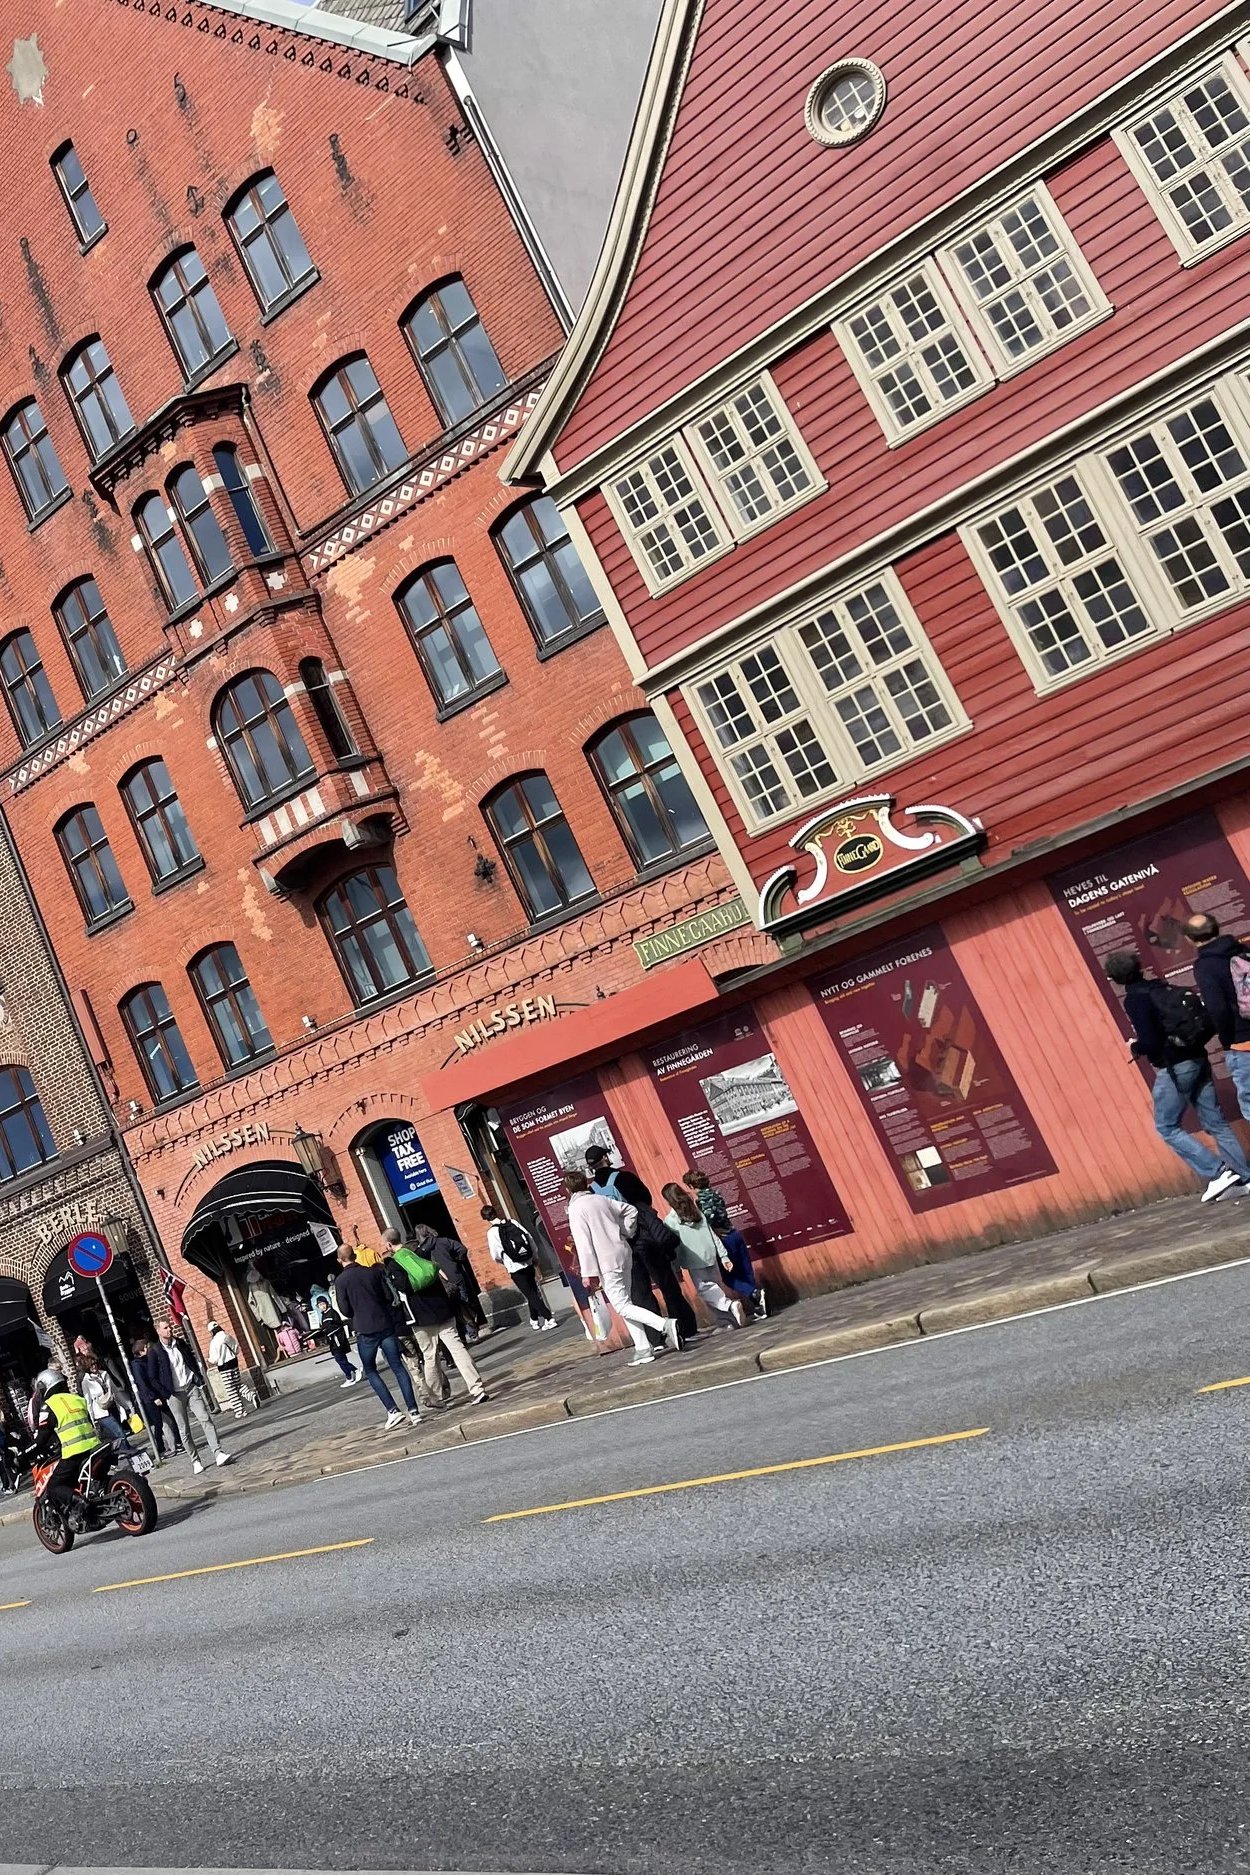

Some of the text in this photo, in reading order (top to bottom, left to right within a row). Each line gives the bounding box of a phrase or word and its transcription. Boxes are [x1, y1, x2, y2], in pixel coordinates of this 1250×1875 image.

[1063, 874, 1108, 898] HEVES TIL
[1068, 886, 1109, 908] DAGENS
[1110, 864, 1160, 891] GATENIVÅ
[820, 947, 933, 998] NYTT OG GAMMELT FORENES
[454, 995, 556, 1053] NILSSEN
[652, 1043, 699, 1067] RESTAURERING
[656, 1048, 714, 1076] AV FINNEGÅRDEN
[509, 1110, 536, 1126] BRYGGEN
[536, 1106, 547, 1115] OG
[512, 1125, 521, 1134] DE
[521, 1120, 535, 1131] SOM
[535, 1110, 558, 1125] FORMET
[559, 1104, 575, 1115] BYEN
[193, 1122, 269, 1169] NILSSEN
[388, 1127, 416, 1147] SHOP
[392, 1141, 415, 1159] TAX
[397, 1151, 425, 1172] FREE
[37, 1200, 98, 1243] BERLE
[234, 1252, 255, 1264] Inspired
[255, 1248, 263, 1257] by
[264, 1241, 281, 1253] nature
[285, 1230, 311, 1244] designed
